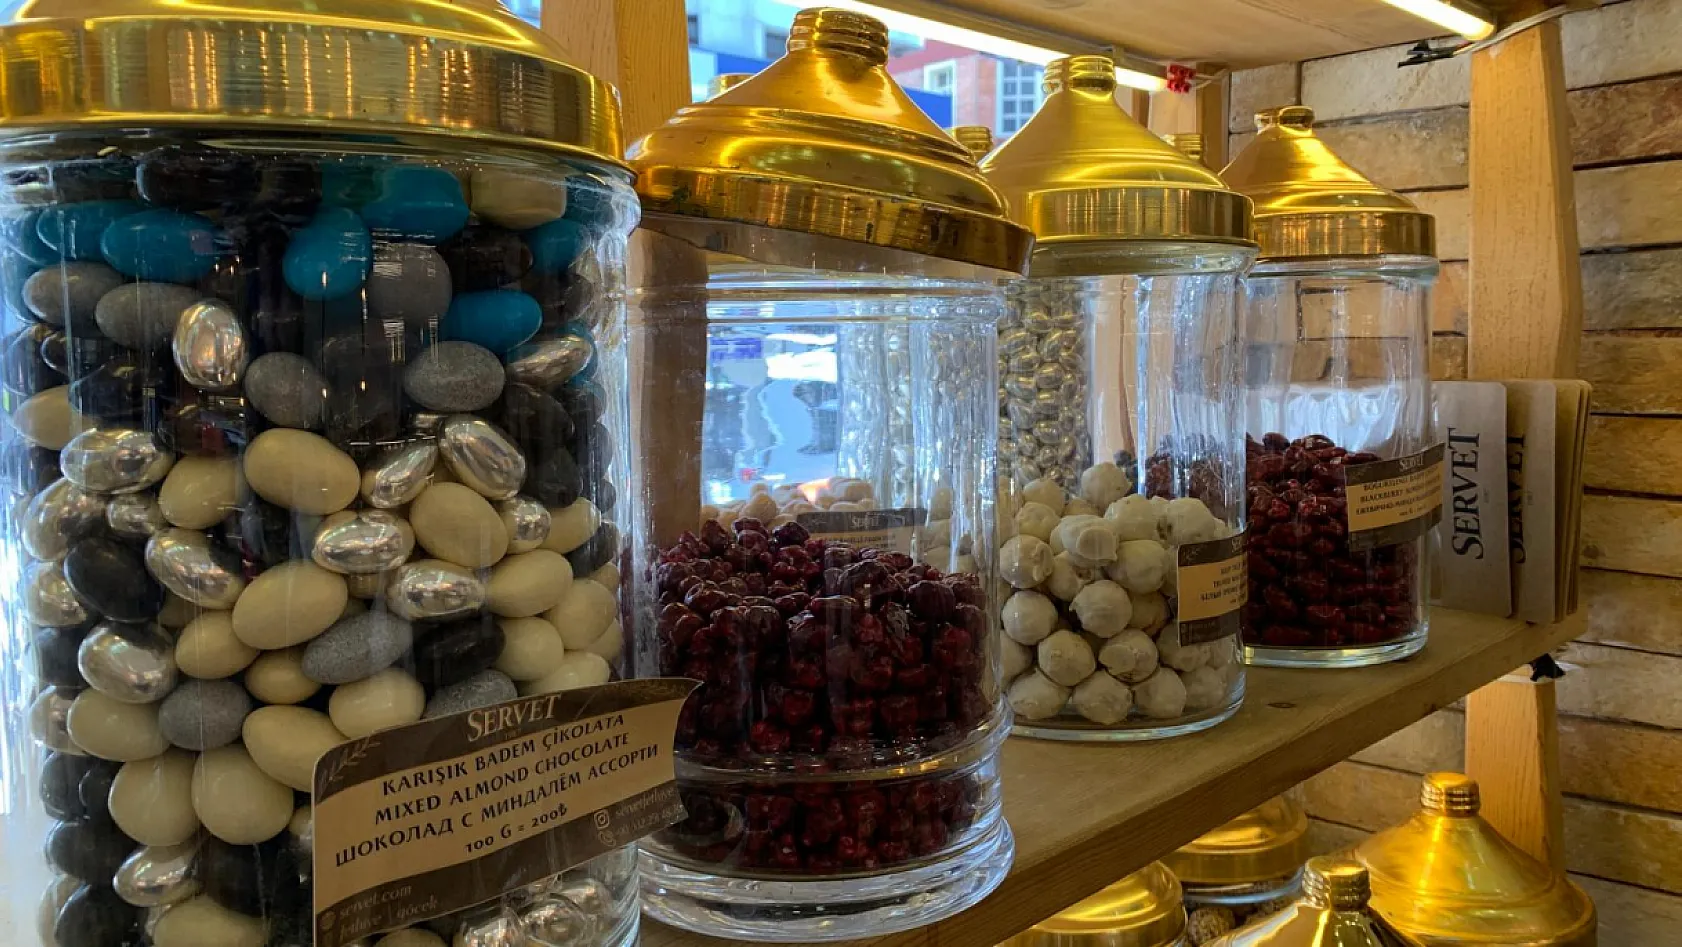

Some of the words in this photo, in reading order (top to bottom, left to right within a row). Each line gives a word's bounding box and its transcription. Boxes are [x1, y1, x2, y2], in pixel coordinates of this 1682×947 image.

[1447, 427, 1484, 559] SERVET
[383, 761, 468, 796] KARIŞIK
[475, 739, 536, 772] BADEM
[542, 714, 624, 752] ÇİKOLATA
[467, 693, 562, 743] SERVET
[335, 817, 454, 868] ШОКОЛАД
[461, 811, 474, 829] С
[481, 771, 581, 823] МИНДАЛЁМ
[588, 743, 659, 781] АССОРТИ
[375, 793, 441, 825] MIXED
[450, 766, 529, 806] ALMOND
[535, 732, 629, 775] CHOCOLATE
[464, 836, 494, 853] 100
[501, 823, 512, 839] G
